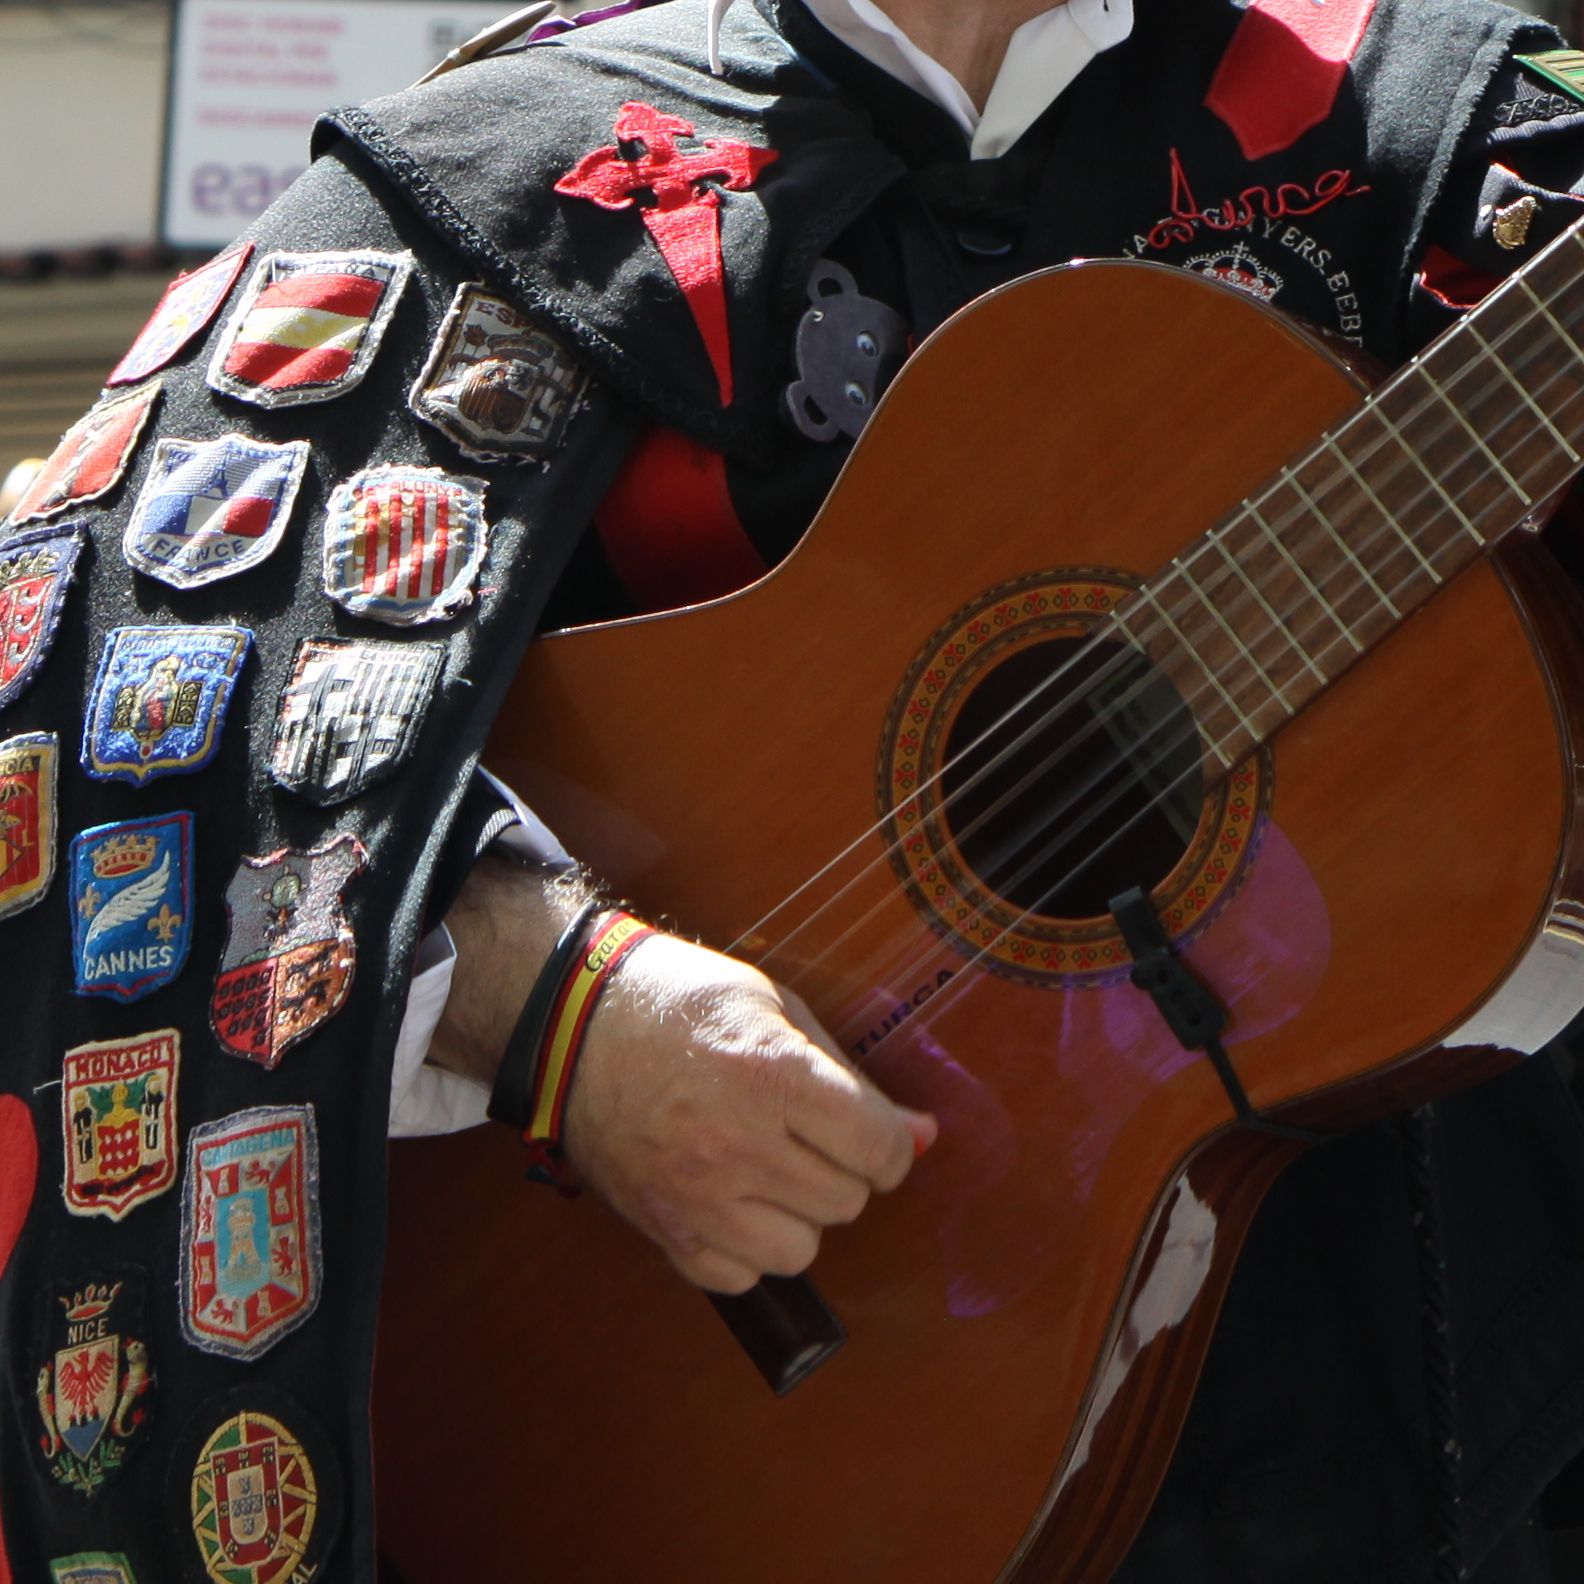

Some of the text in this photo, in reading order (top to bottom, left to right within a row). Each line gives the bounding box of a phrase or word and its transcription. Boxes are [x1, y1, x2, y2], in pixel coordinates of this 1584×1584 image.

[152, 537, 245, 563] FRANCE
[84, 945, 174, 981] CANNES
[69, 1039, 169, 1082] MONACO
[201, 1128, 296, 1168] CARTAGENA
[67, 1317, 109, 1345] NICE
